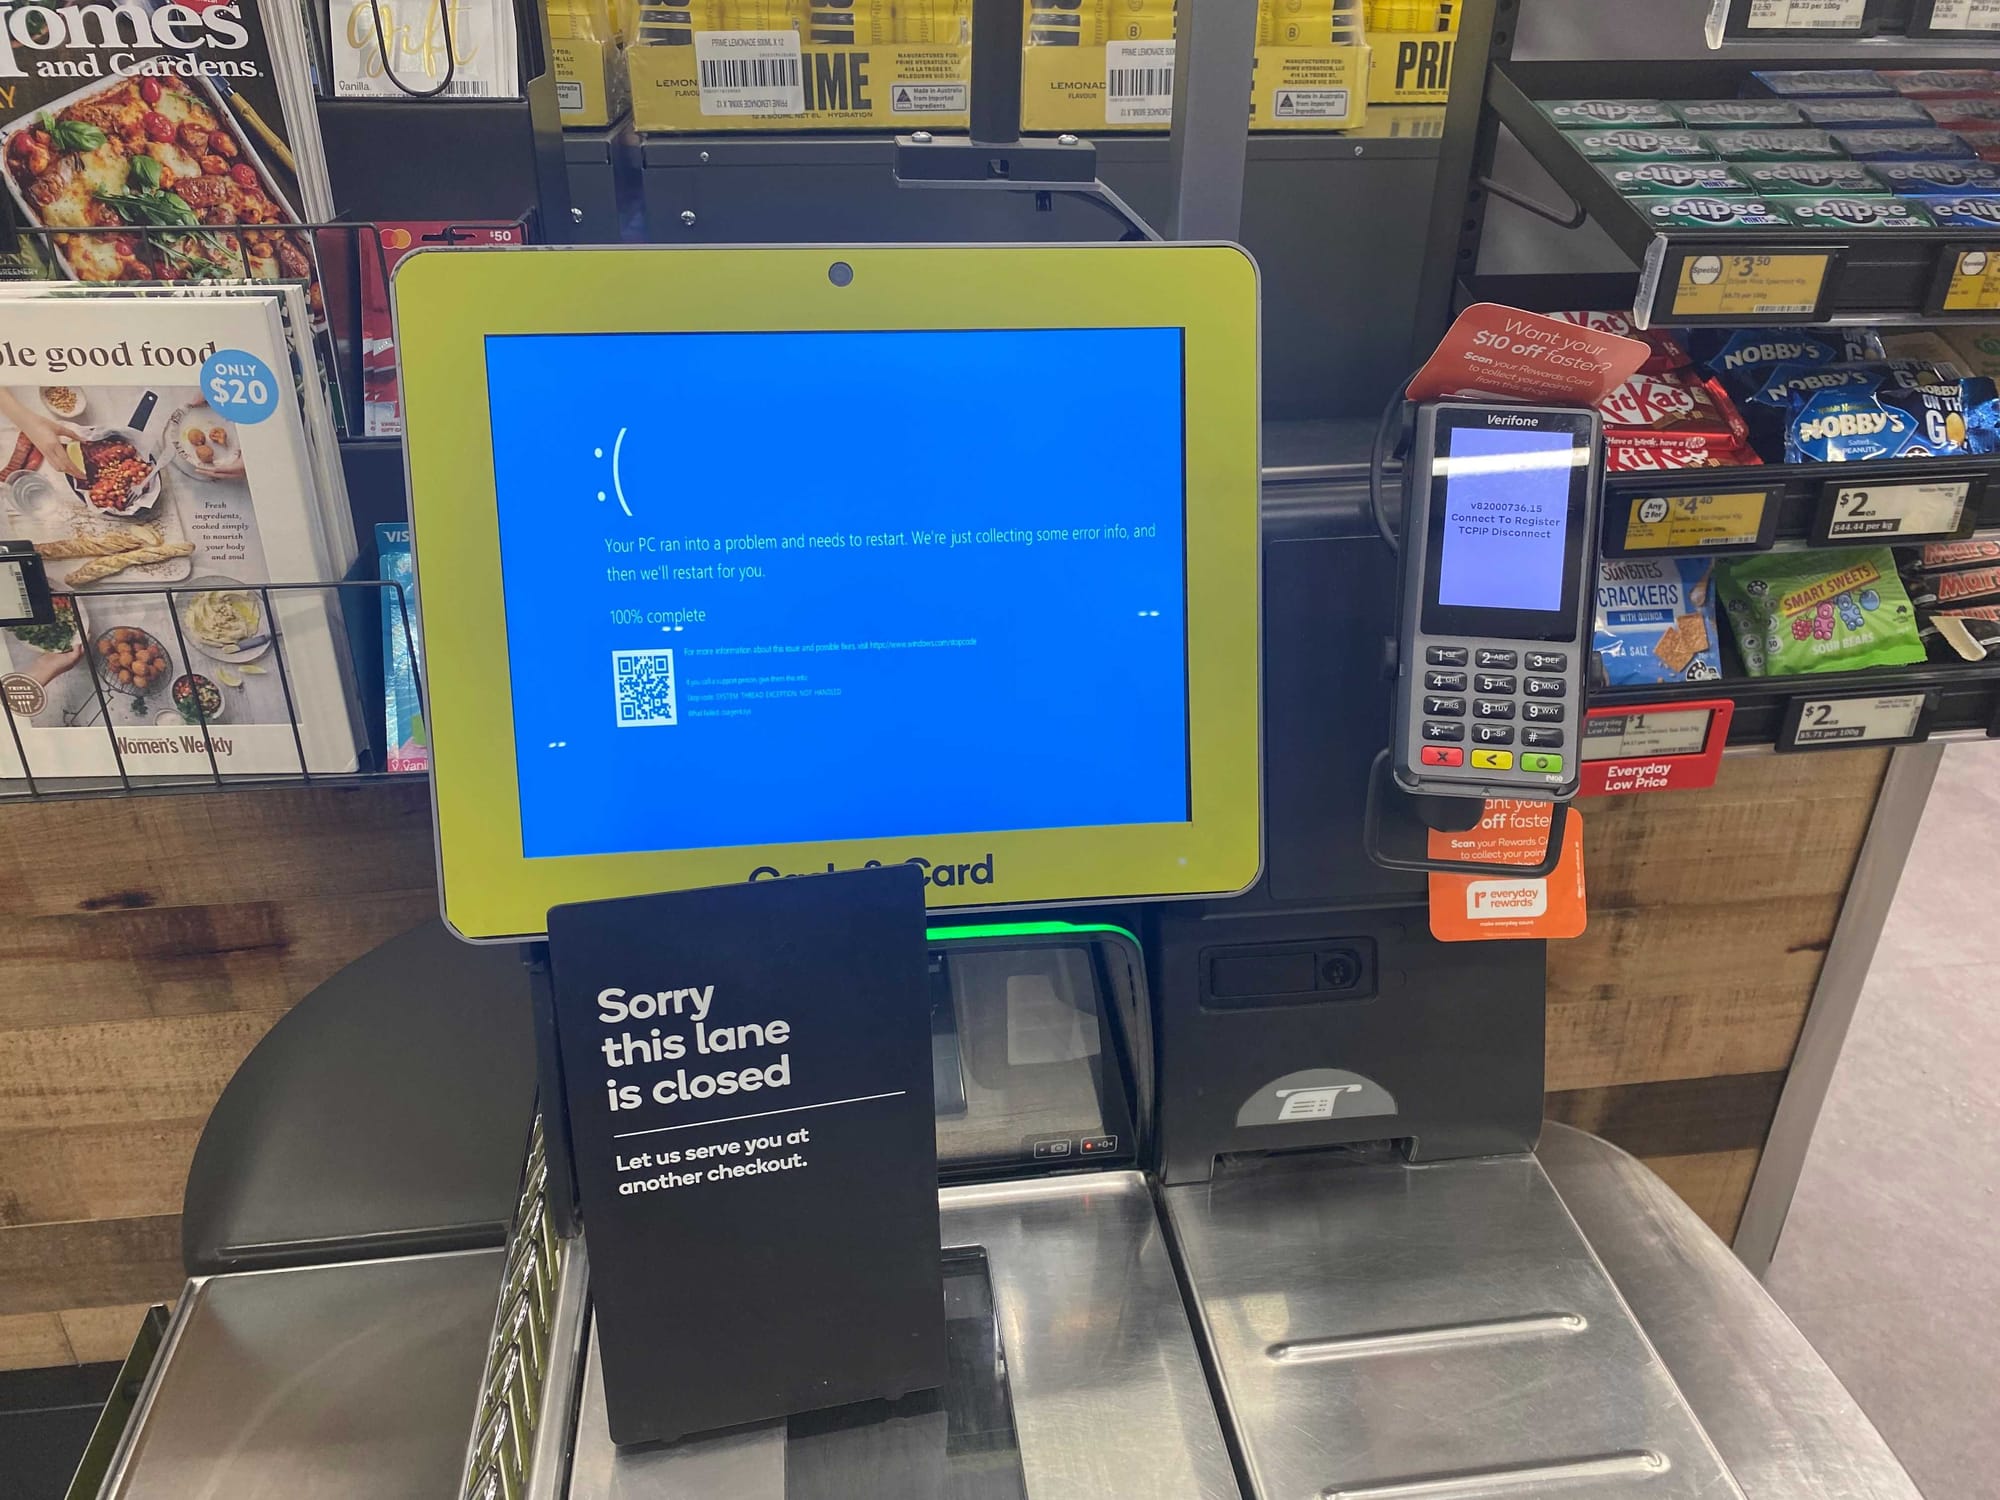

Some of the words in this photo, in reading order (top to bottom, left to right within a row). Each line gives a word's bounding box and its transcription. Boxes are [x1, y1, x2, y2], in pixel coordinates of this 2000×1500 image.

[1130, 26, 1137, 36] B
[36, 53, 103, 77] and
[109, 53, 264, 78] Gardens.
[1554, 103, 1657, 120] eclipse
[1583, 131, 1692, 150] eclipse
[1615, 164, 1726, 184] eclipse
[1752, 164, 1864, 184] eclipse
[1888, 164, 1995, 182] eclipse
[1650, 198, 1766, 222] eclipse
[1794, 199, 1907, 223] eclipse
[1743, 216, 1769, 224] MINTS
[1884, 218, 1909, 226] MINTS
[490, 231, 511, 242] $50
[1505, 318, 1560, 345] Want
[1562, 338, 1608, 357] your
[45, 341, 134, 373] good
[1473, 329, 1510, 350] $10
[1512, 343, 1545, 359] off
[1544, 350, 1613, 375] faster?
[1724, 341, 1820, 370] NOBBY'S
[215, 363, 257, 378] ONLY
[1464, 351, 1493, 365] Scan
[1494, 360, 1518, 371] your
[1519, 365, 1564, 380] Rewards
[1566, 375, 1595, 388] Card
[1469, 364, 1480, 373] to
[1481, 368, 1517, 381] collect
[1518, 375, 1542, 387] your
[209, 377, 268, 408] $20
[1923, 396, 1944, 413] ON
[1487, 414, 1539, 427] Verifone
[1801, 412, 1905, 443] NOBBY'S
[1608, 437, 1627, 446] Have
[1843, 446, 1876, 455] PEANUTS
[1470, 502, 1543, 513] v82000736.15
[1647, 503, 1663, 511] Any
[1840, 492, 1868, 517] $2
[192, 522, 220, 530] cooked
[1451, 513, 1496, 524] Connect
[1498, 515, 1512, 525] To
[1515, 516, 1561, 528] Register
[1834, 523, 1865, 532] $44.44
[1865, 523, 1880, 533] per
[1882, 521, 1893, 531] kg
[605, 537, 635, 553] Your
[638, 536, 656, 552] PC
[660, 539, 681, 552] ran
[685, 536, 711, 551] into
[713, 541, 721, 550] a
[725, 533, 777, 555] problem
[781, 533, 805, 549] and
[808, 532, 846, 548] needs
[849, 533, 863, 547] to
[866, 531, 908, 547] restart.
[911, 530, 946, 545] We're
[950, 529, 972, 548] just
[975, 527, 1033, 547] collecting
[1036, 529, 1069, 542] some
[1072, 528, 1101, 541] error
[1104, 524, 1130, 541] info,
[1133, 523, 1156, 538] and
[1458, 526, 1489, 536] TCPIP
[1491, 528, 1552, 539] Disconnect
[607, 566, 637, 582] then
[640, 565, 668, 580] we'll
[673, 565, 714, 580] restart
[717, 563, 735, 579] for
[739, 566, 766, 583] you.
[1601, 563, 1663, 581] SUNBITES
[1783, 586, 1826, 612] SMART
[1828, 565, 1873, 593] SWEETS
[1938, 567, 2000, 599] Mar
[1597, 584, 1679, 608] CRACKERS
[610, 609, 643, 625] 100%
[647, 607, 706, 627] complete
[1620, 613, 1638, 622] WITH
[1630, 645, 1648, 657] SALT
[1812, 640, 1841, 656] SOUR
[1842, 631, 1874, 649] BEARS
[1437, 649, 1443, 662] 1
[1481, 652, 1492, 664] 2
[1533, 655, 1543, 667] 3
[1433, 675, 1443, 687] 4
[1483, 678, 1493, 690] 5
[1530, 680, 1540, 693] 6
[1432, 699, 1442, 712] 7
[1481, 702, 1492, 715] 8
[1529, 705, 1539, 718] 9
[1588, 718, 1623, 728] Everyday
[1805, 704, 1832, 726] $2
[1481, 728, 1491, 740] 0
[1799, 731, 1823, 739] $5.71
[1824, 730, 1838, 739] per
[1839, 728, 1860, 738] 100g
[117, 737, 180, 755] Women's
[179, 735, 233, 757] Wekly
[1607, 763, 1672, 778] Everyday
[1604, 780, 1633, 791] Low
[1635, 777, 1668, 789] Price
[1481, 813, 1507, 830] off
[1451, 839, 1476, 849] Scan
[1477, 840, 1496, 850] your
[1498, 837, 1537, 847] Rewards
[1460, 851, 1470, 859] to
[1472, 850, 1501, 859] collect
[1503, 850, 1522, 860] your
[1490, 888, 1539, 900] everyday
[1490, 897, 1533, 909] rewards
[597, 985, 715, 1024] Sorry
[601, 1028, 687, 1068] this
[695, 1019, 791, 1055] lane
[606, 1078, 643, 1112] is
[652, 1053, 792, 1105] closed
[616, 1152, 653, 1172] Let
[656, 1150, 682, 1166] us
[685, 1141, 741, 1161] serve
[744, 1134, 783, 1156] you
[786, 1128, 810, 1145] at
[618, 1170, 704, 1196] another
[707, 1153, 809, 1182] checkout.
